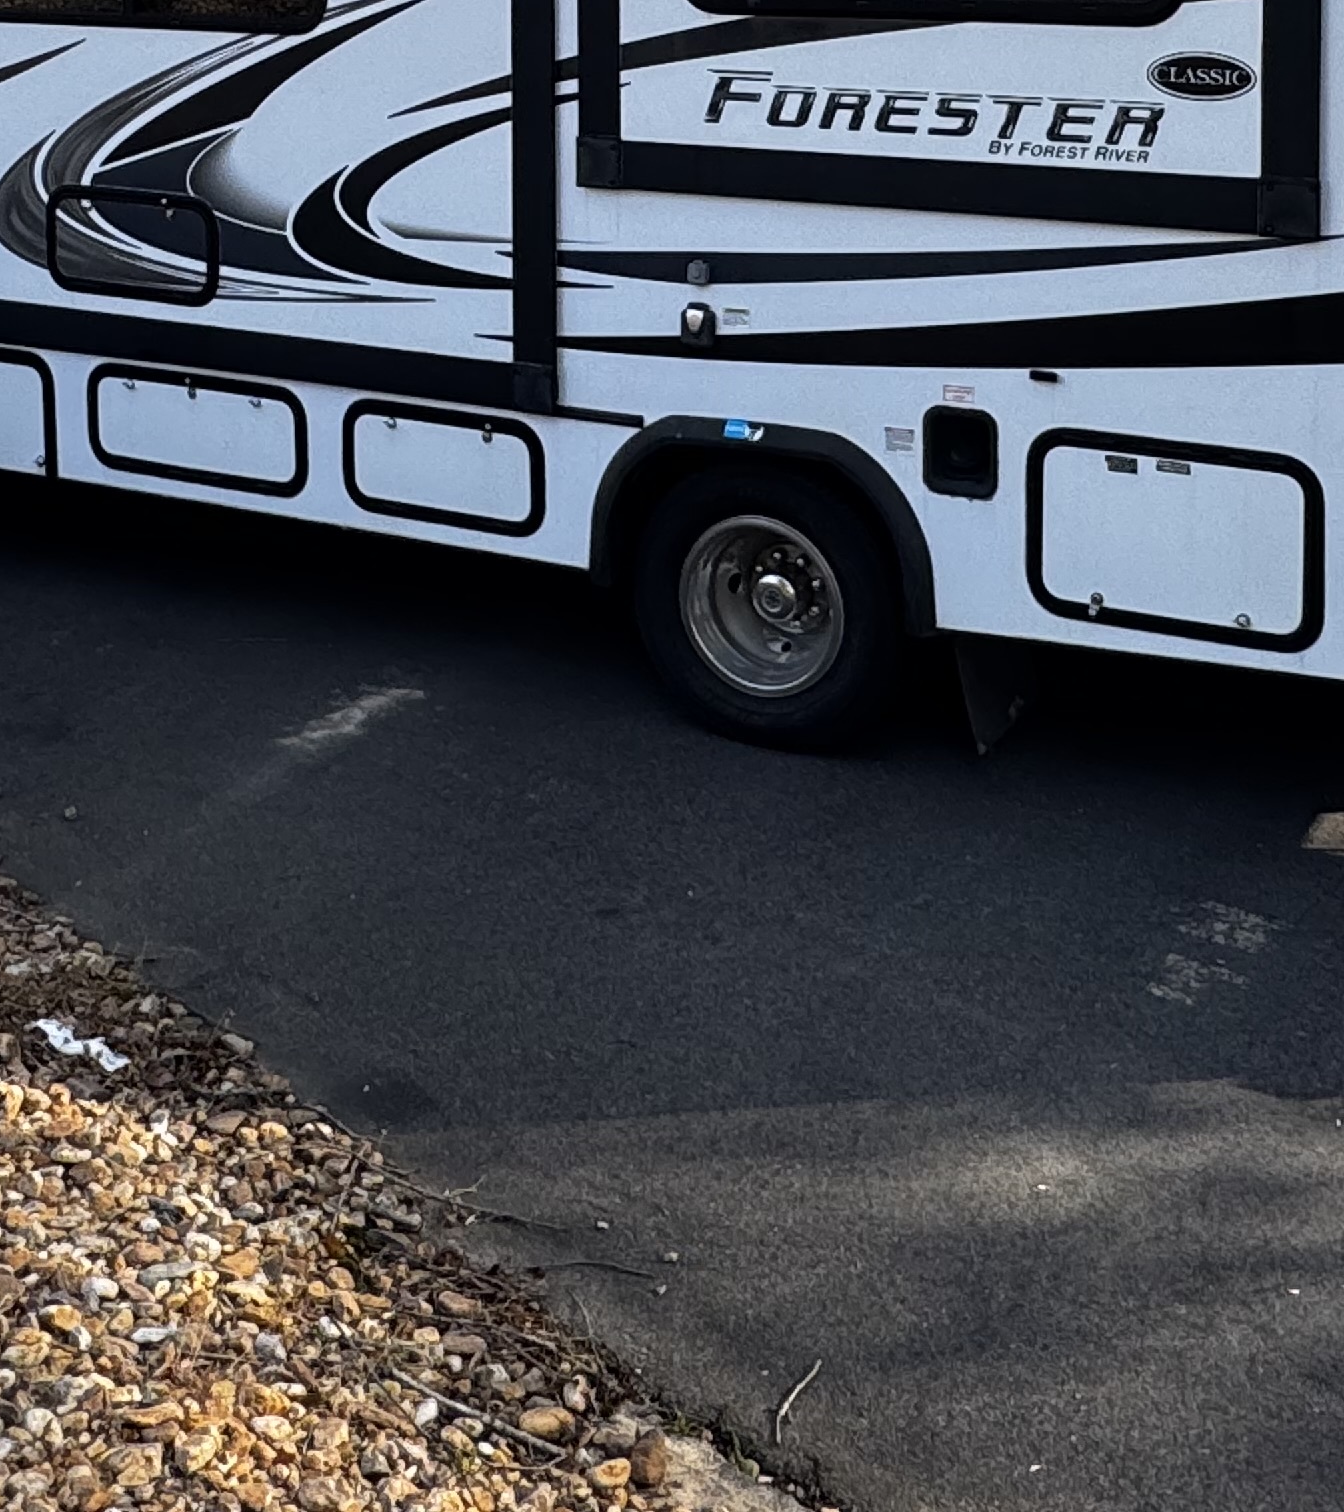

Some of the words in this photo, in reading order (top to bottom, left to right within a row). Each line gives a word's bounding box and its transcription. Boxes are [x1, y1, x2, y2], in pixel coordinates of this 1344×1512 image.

[1153, 65, 1248, 86] CLASSIC
[704, 68, 1166, 148] FORESTER
[988, 140, 1014, 156] BY
[1018, 141, 1090, 160] FOREST
[1094, 145, 1151, 164] RIVER
